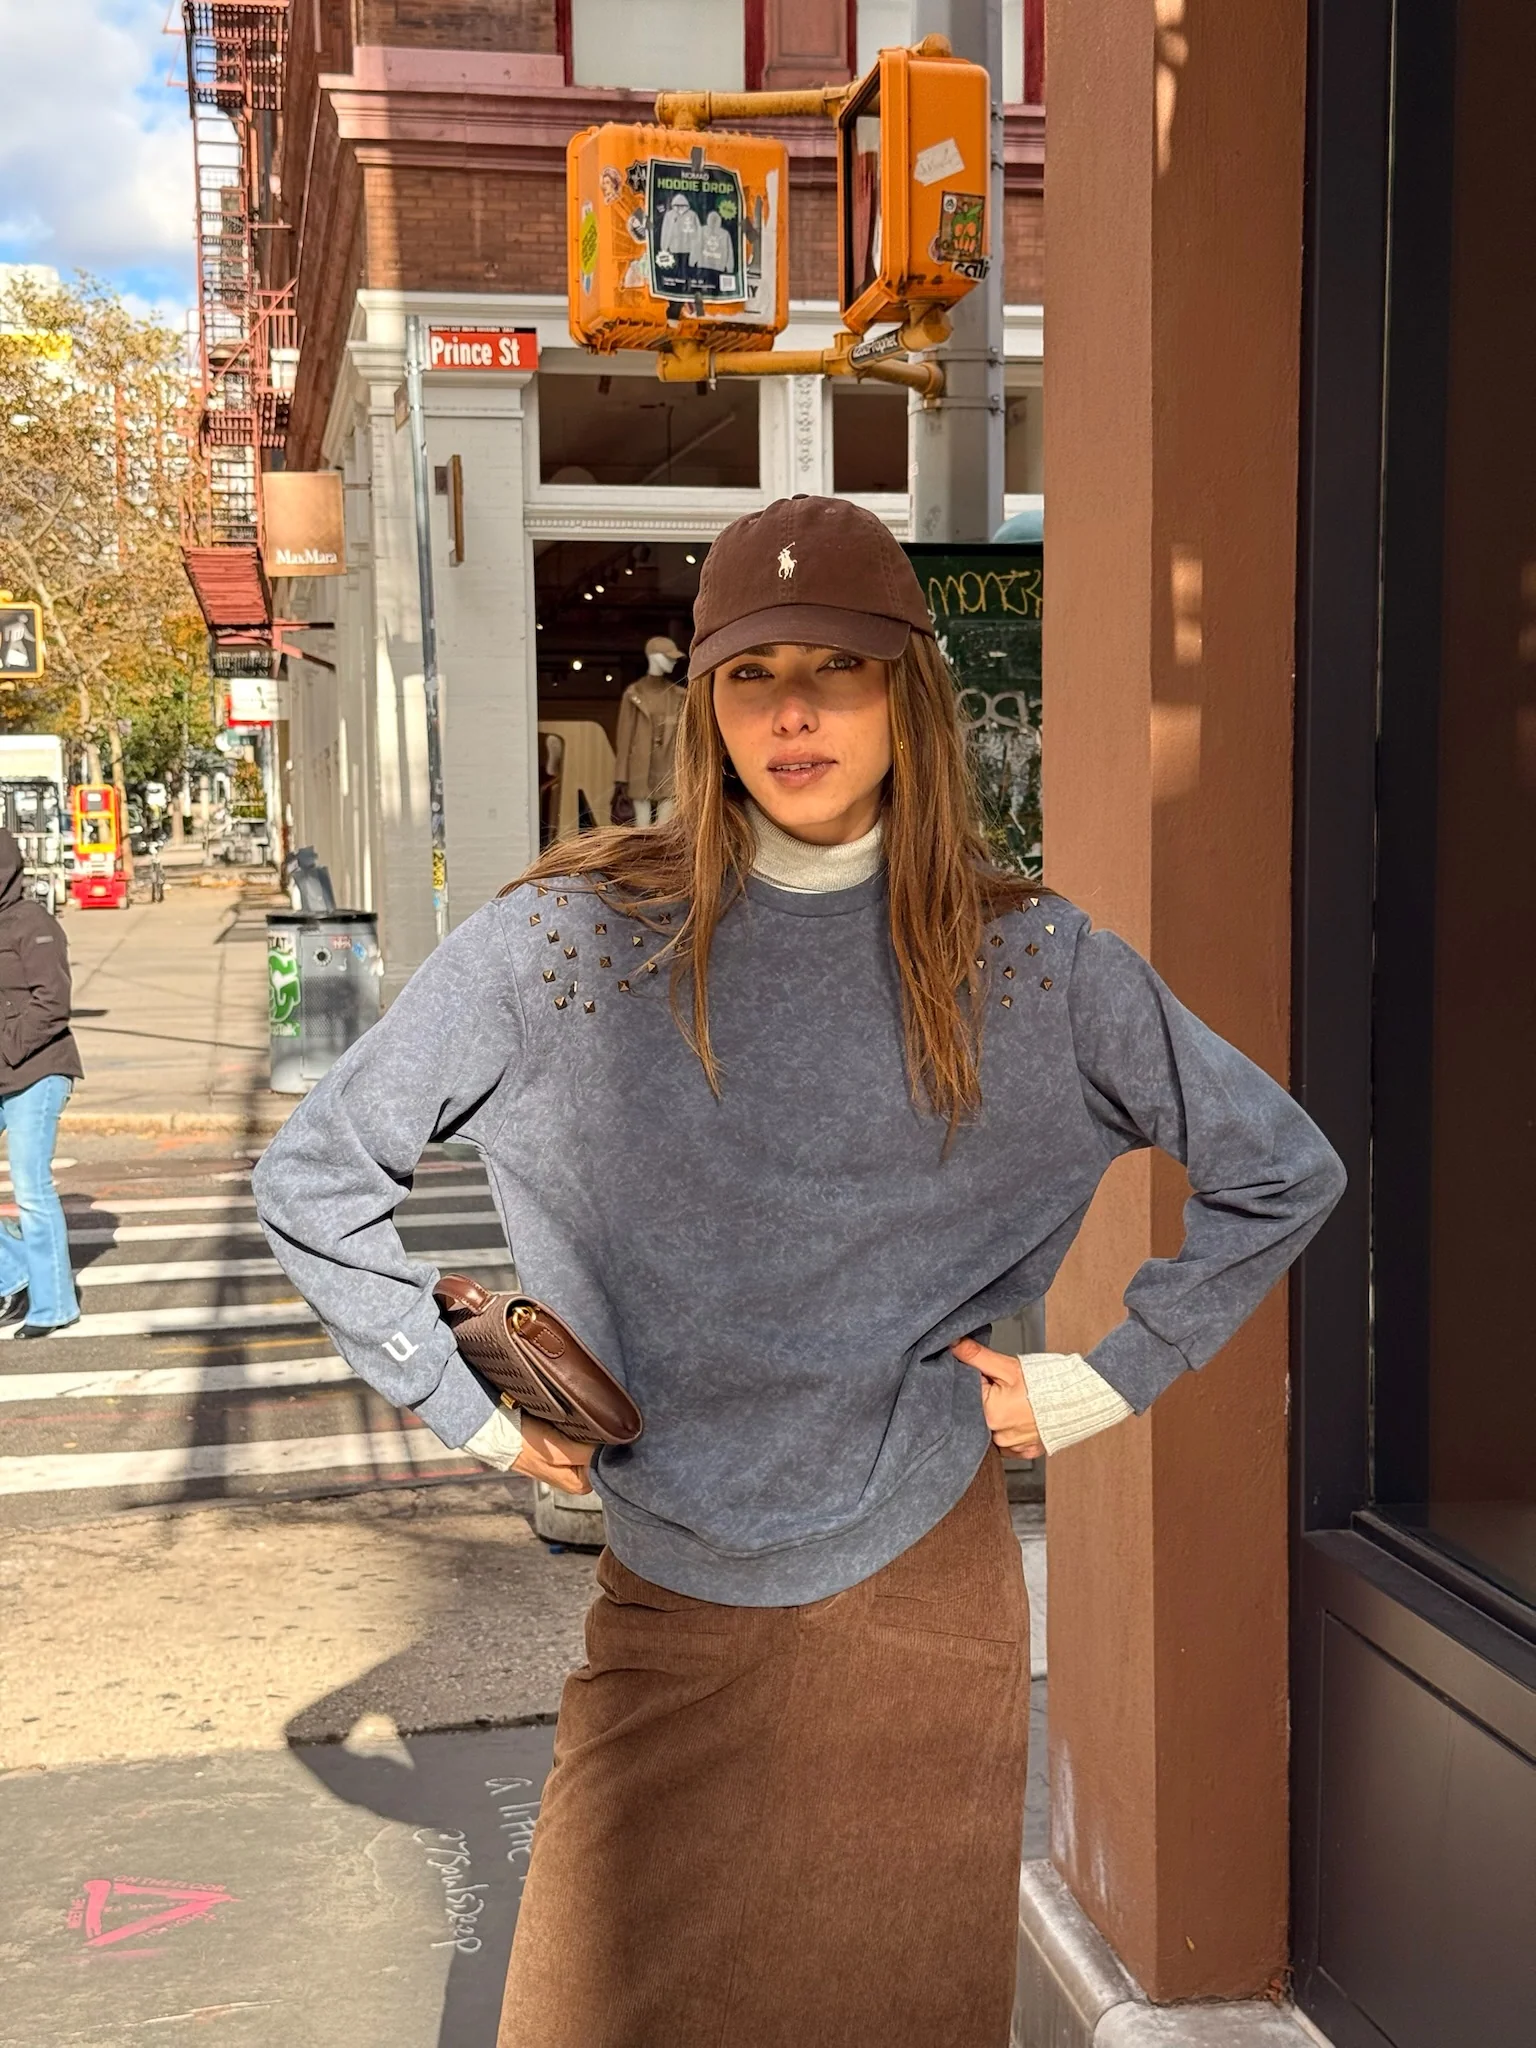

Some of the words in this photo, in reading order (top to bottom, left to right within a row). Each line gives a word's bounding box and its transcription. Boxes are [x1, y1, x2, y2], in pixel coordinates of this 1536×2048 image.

[657, 179, 700, 192] HOODIE
[702, 181, 735, 195] DROP
[430, 335, 493, 366] Prince
[499, 336, 521, 367] St
[276, 547, 338, 565] MaxMara
